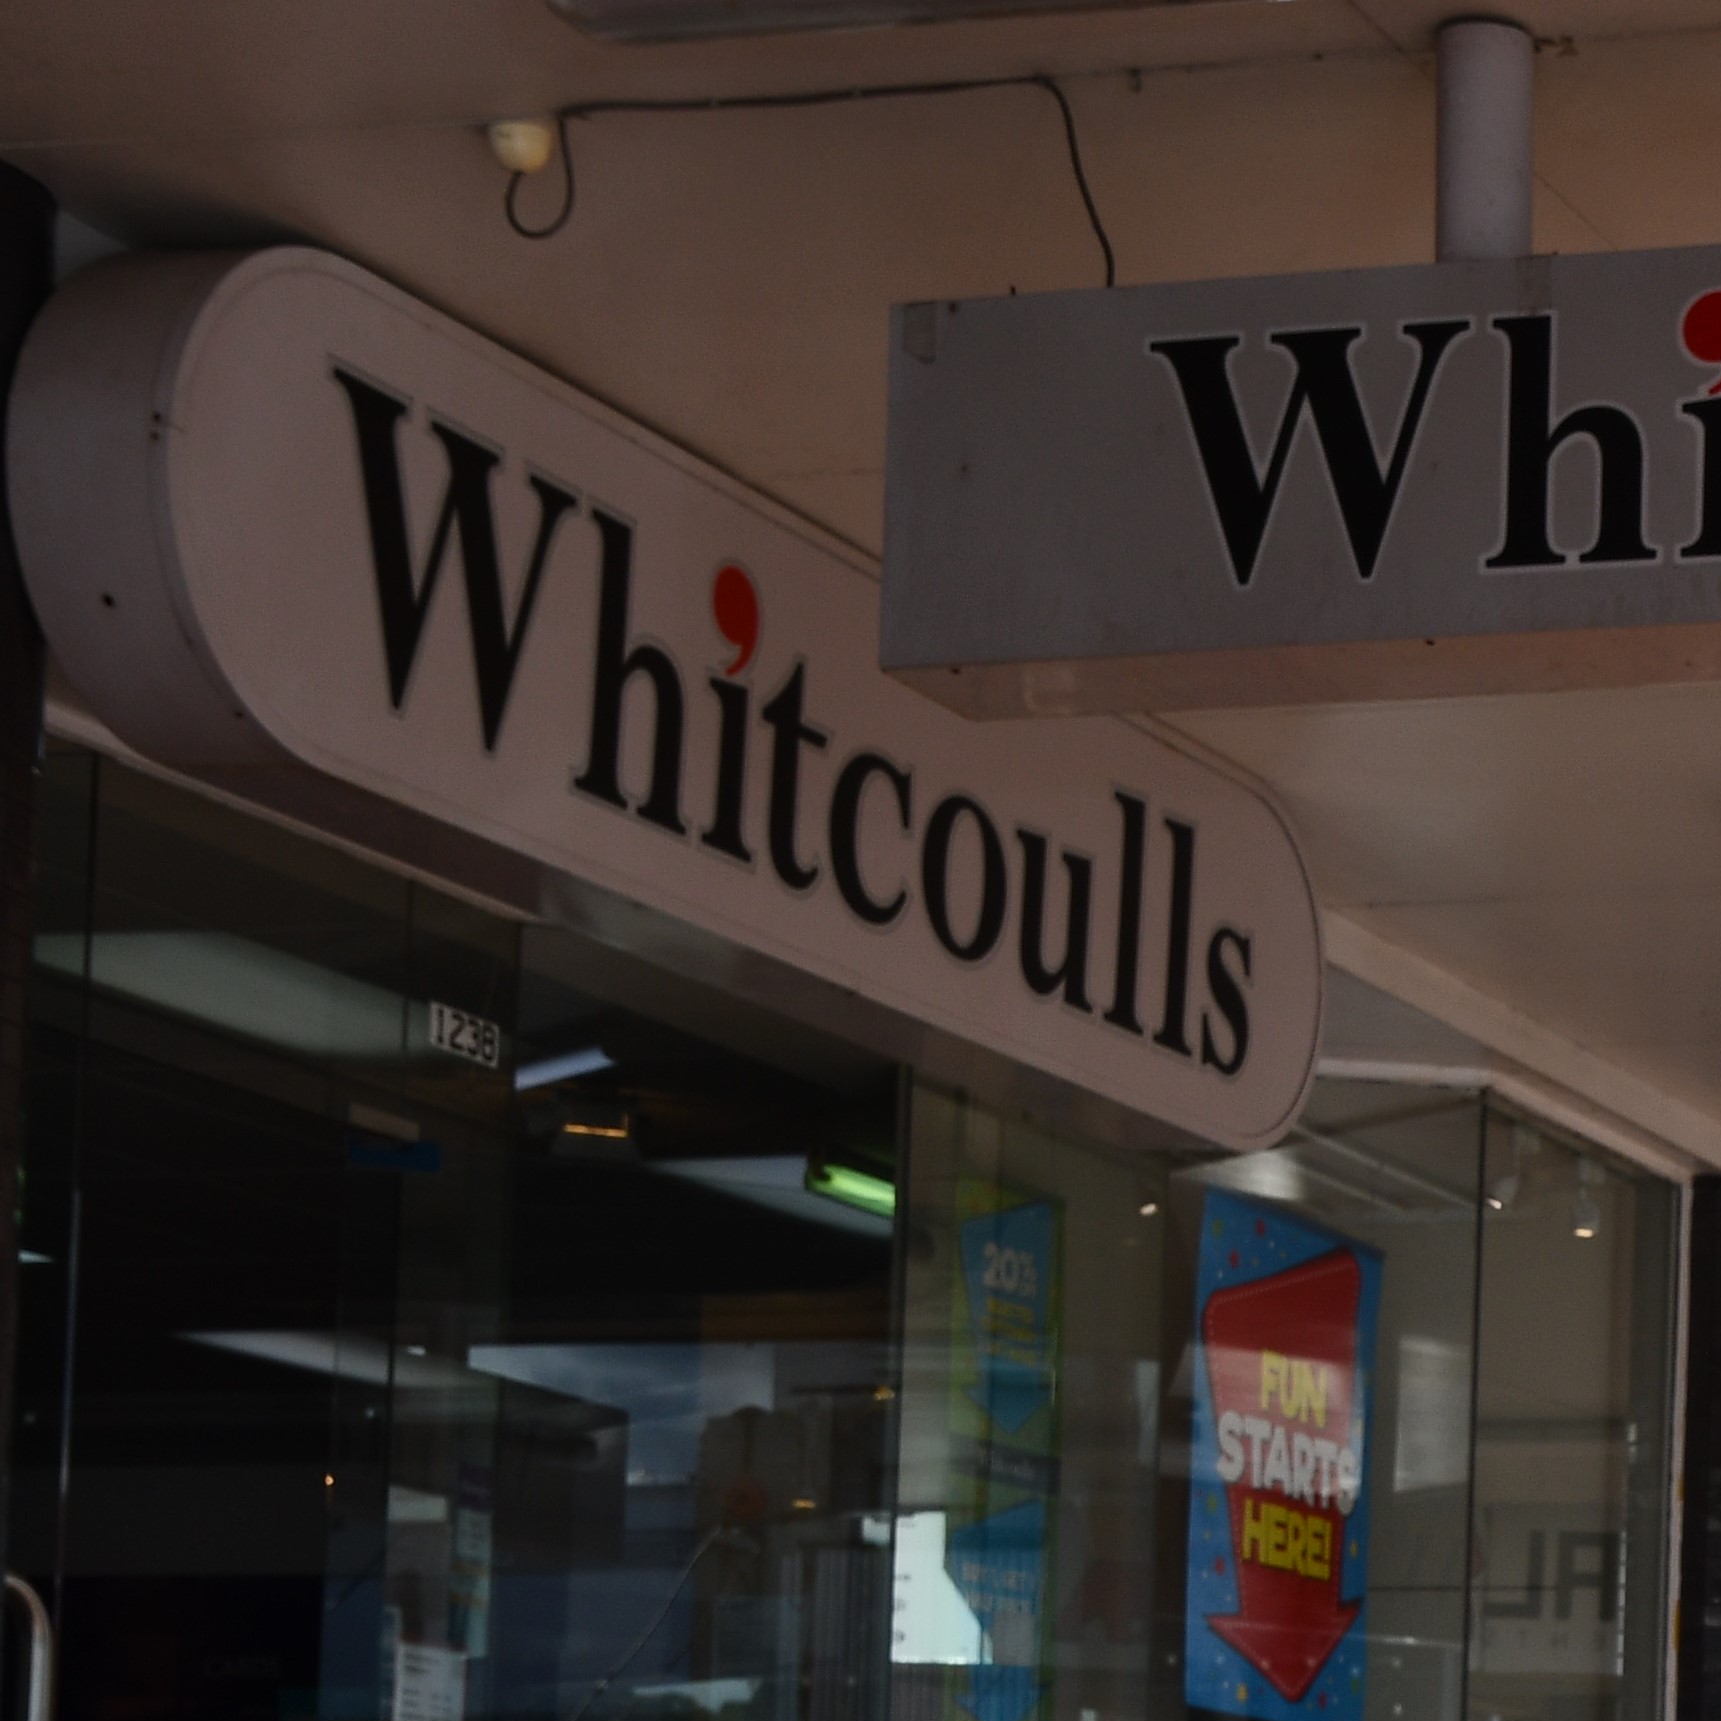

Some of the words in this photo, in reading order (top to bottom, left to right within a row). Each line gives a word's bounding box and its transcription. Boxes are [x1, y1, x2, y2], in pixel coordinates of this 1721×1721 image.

[331, 358, 1255, 1078] Whitcoulls
[1260, 1348, 1328, 1429] FUN
[1216, 1410, 1361, 1516] STARTS
[1242, 1496, 1334, 1582] HERE!
